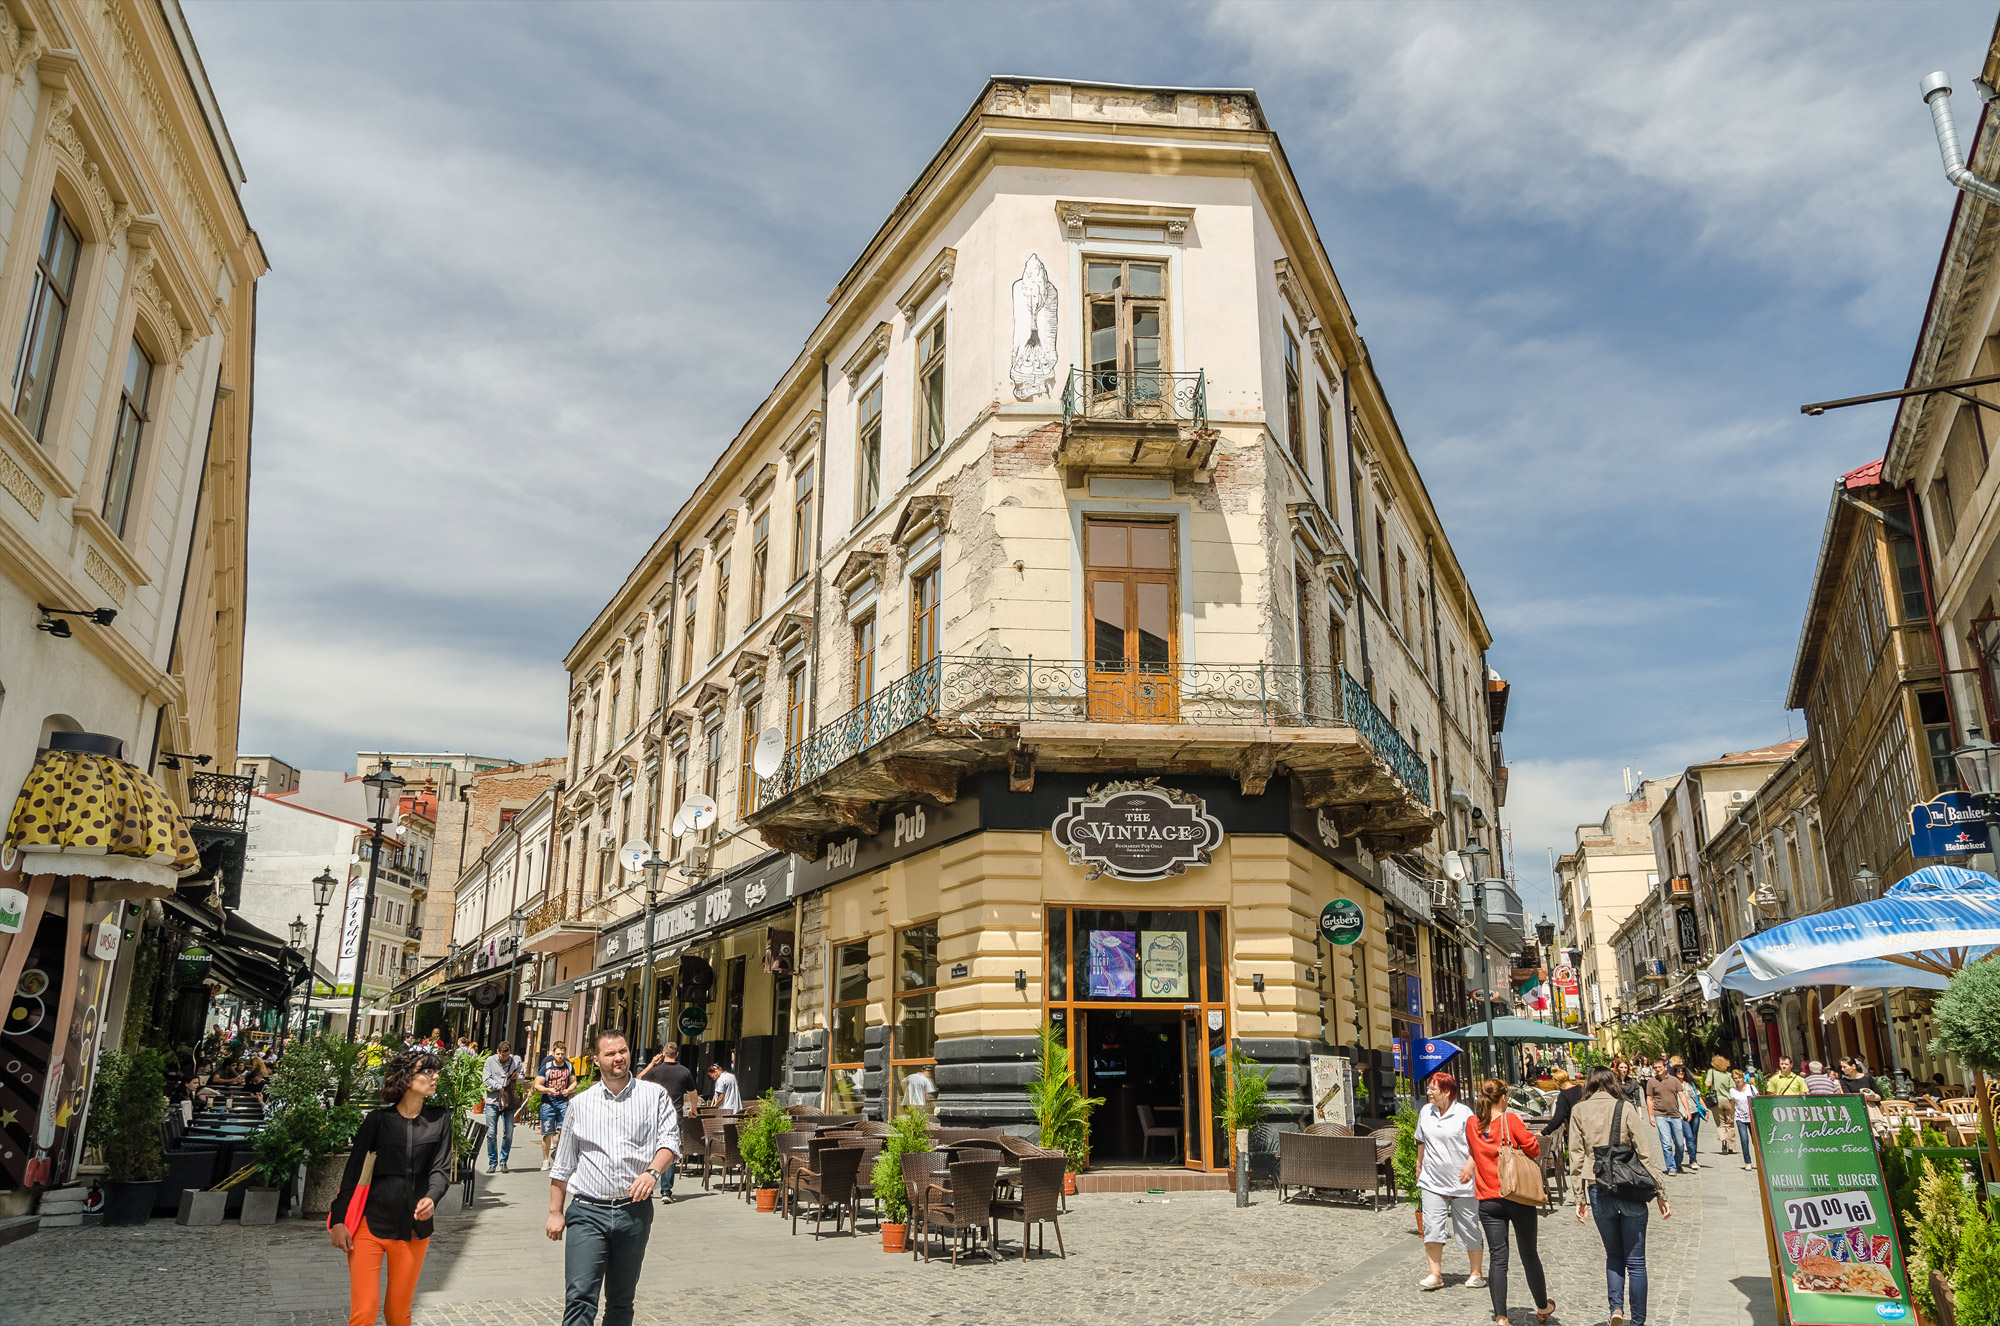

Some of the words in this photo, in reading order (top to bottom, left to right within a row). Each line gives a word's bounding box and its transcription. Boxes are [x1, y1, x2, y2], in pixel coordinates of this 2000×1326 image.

[1124, 813, 1151, 822] THE
[1930, 811, 1944, 820] The
[894, 804, 926, 848] Pub
[1087, 822, 1192, 845] VINTAGE
[826, 837, 858, 871] Party
[1944, 841, 1986, 852] Heineken
[704, 887, 733, 926] PUB
[1321, 913, 1361, 932] Carlsberg
[1864, 919, 1893, 928] de
[1900, 916, 1961, 925] izvor
[1765, 942, 1796, 952] aqpa
[177, 952, 213, 962] bound
[1772, 1105, 1852, 1122] OFERTA
[1766, 1124, 1793, 1145] La
[1799, 1117, 1864, 1139] haleala
[1797, 1142, 1839, 1159] foamea
[1841, 1143, 1870, 1153] trece
[1771, 1174, 1804, 1187] MENIU
[1810, 1173, 1831, 1186] THE
[1837, 1173, 1879, 1187] BURGER
[1788, 1197, 1843, 1230] 20.00
[1844, 1200, 1872, 1223] lei
